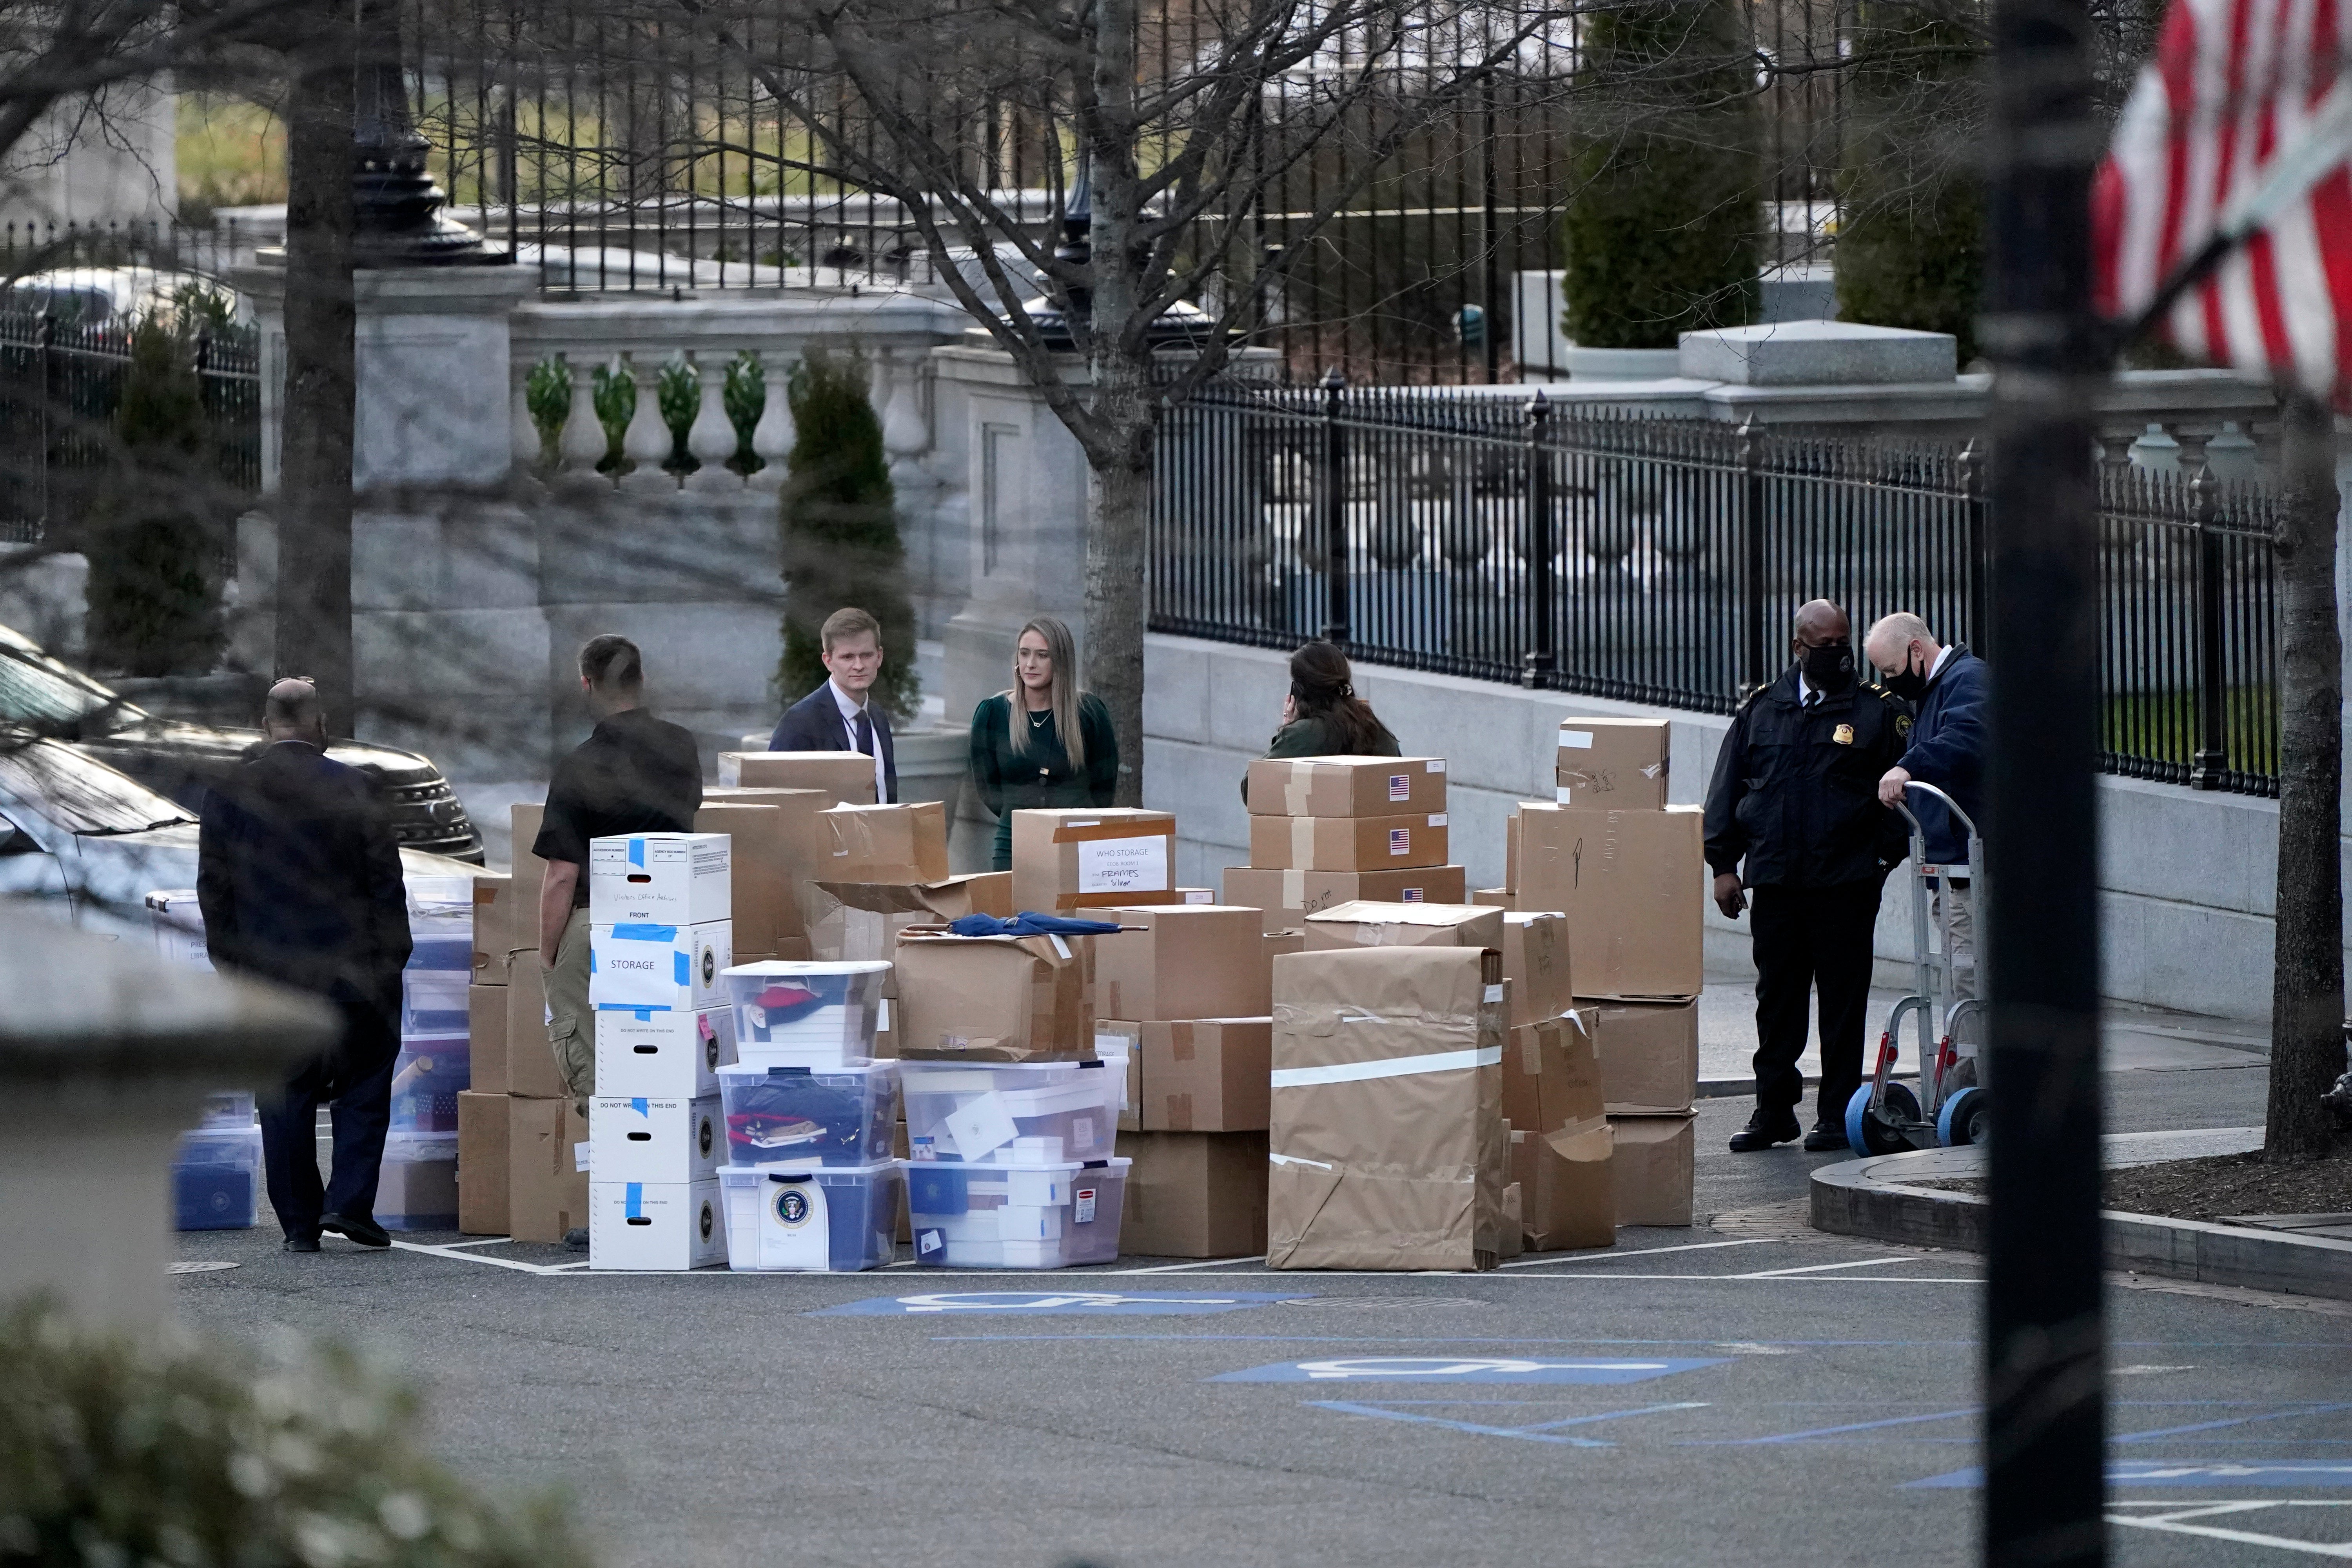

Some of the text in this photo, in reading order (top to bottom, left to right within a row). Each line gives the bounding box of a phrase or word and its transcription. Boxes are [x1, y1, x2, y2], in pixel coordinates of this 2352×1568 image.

[1102, 869, 1139, 878] FRAMES
[1321, 889, 1332, 902] not
[611, 960, 655, 970] STORAGE
